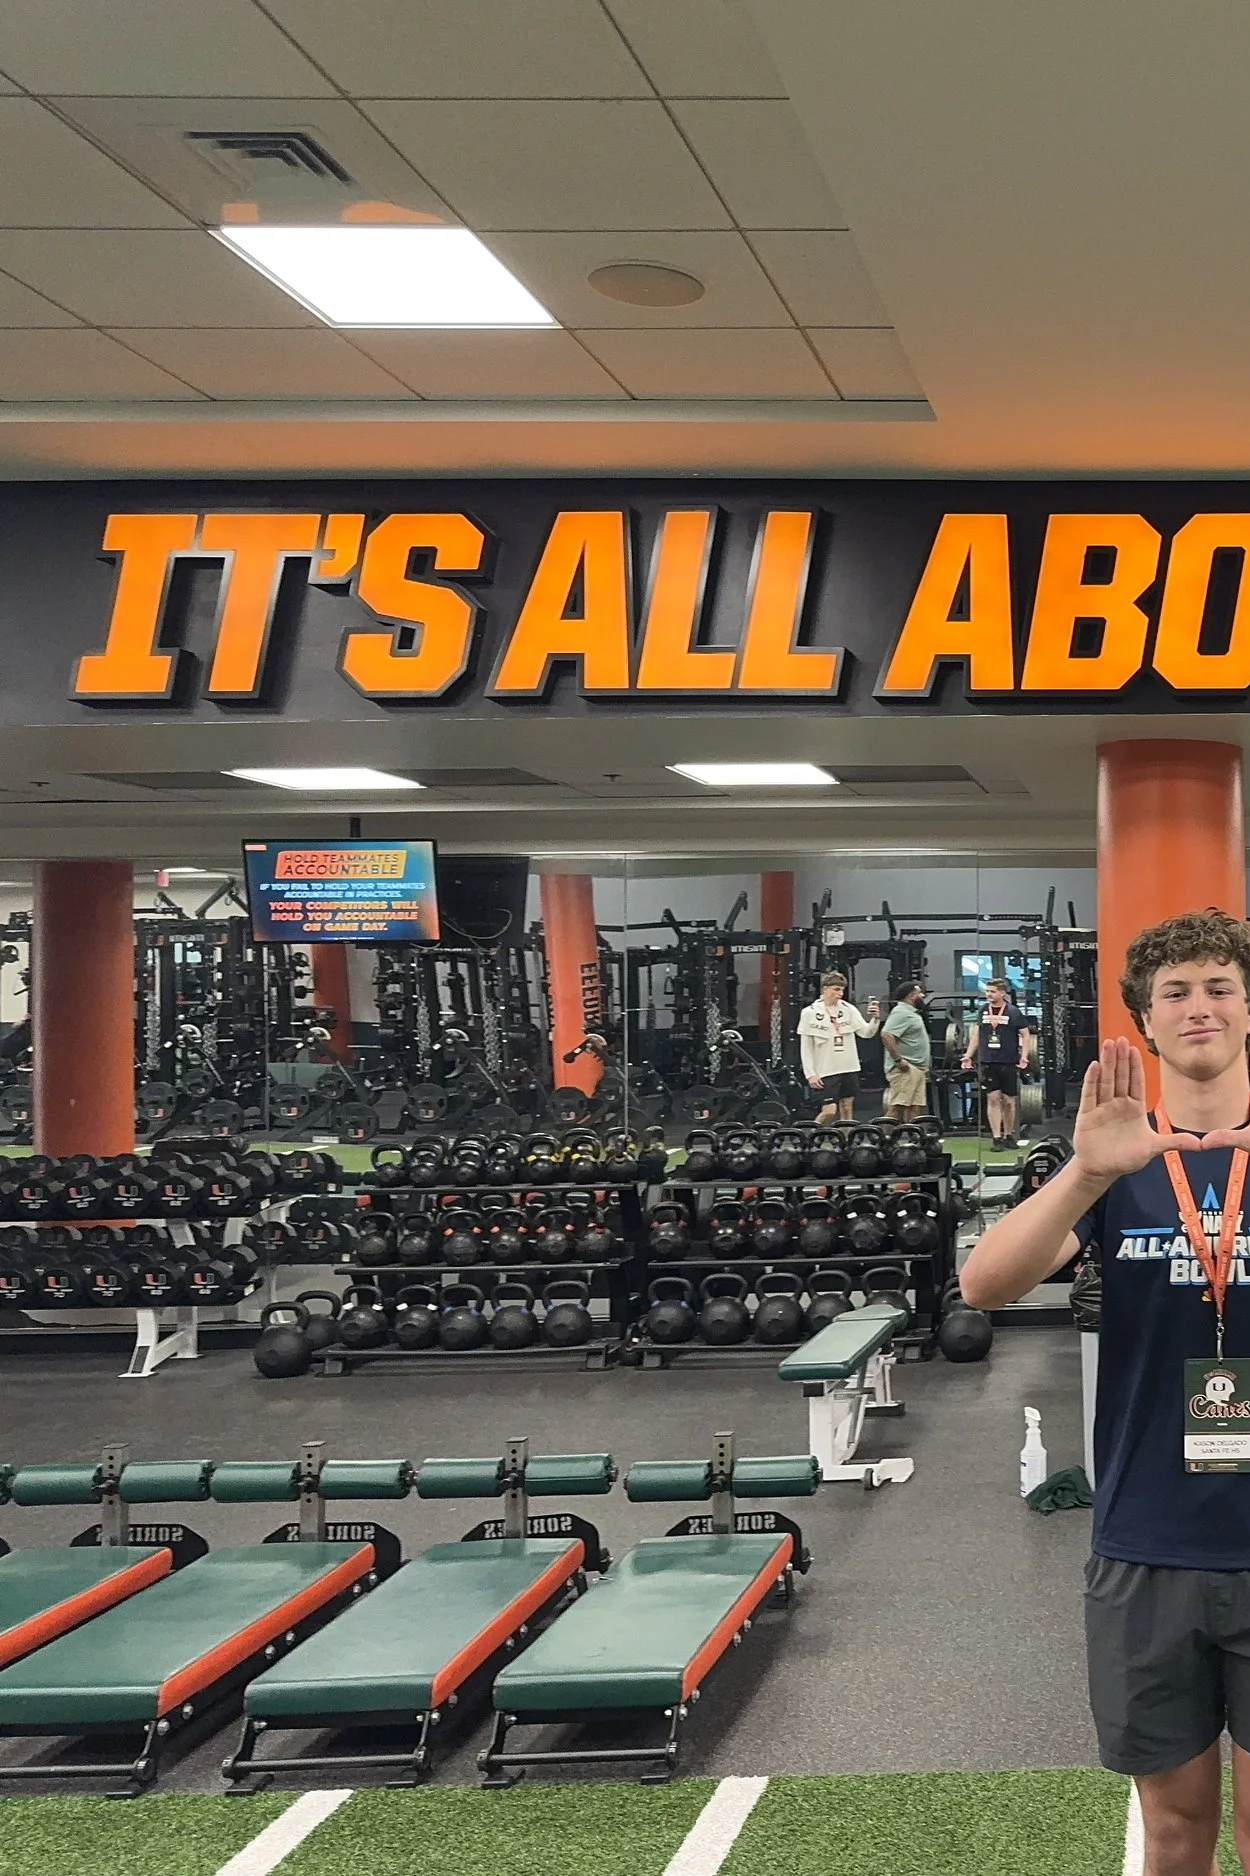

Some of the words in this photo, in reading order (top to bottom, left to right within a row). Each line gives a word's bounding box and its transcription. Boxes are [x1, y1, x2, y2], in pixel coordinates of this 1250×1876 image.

[71, 512, 488, 699] IT'S
[488, 509, 842, 697] ALL
[284, 854, 321, 864] HOLD
[323, 853, 399, 864] TEAMMATES
[284, 864, 399, 876] ACCOUNTABLE
[269, 901, 303, 910] YOUR
[305, 901, 388, 910] COMPETITORS
[391, 901, 419, 909] WILL
[271, 912, 303, 921] HOLD
[307, 912, 332, 921] YOU
[335, 912, 418, 920] ACCOUNTABLE
[303, 923, 322, 931] ON
[324, 923, 359, 931] GAME
[362, 923, 388, 931] DAY.
